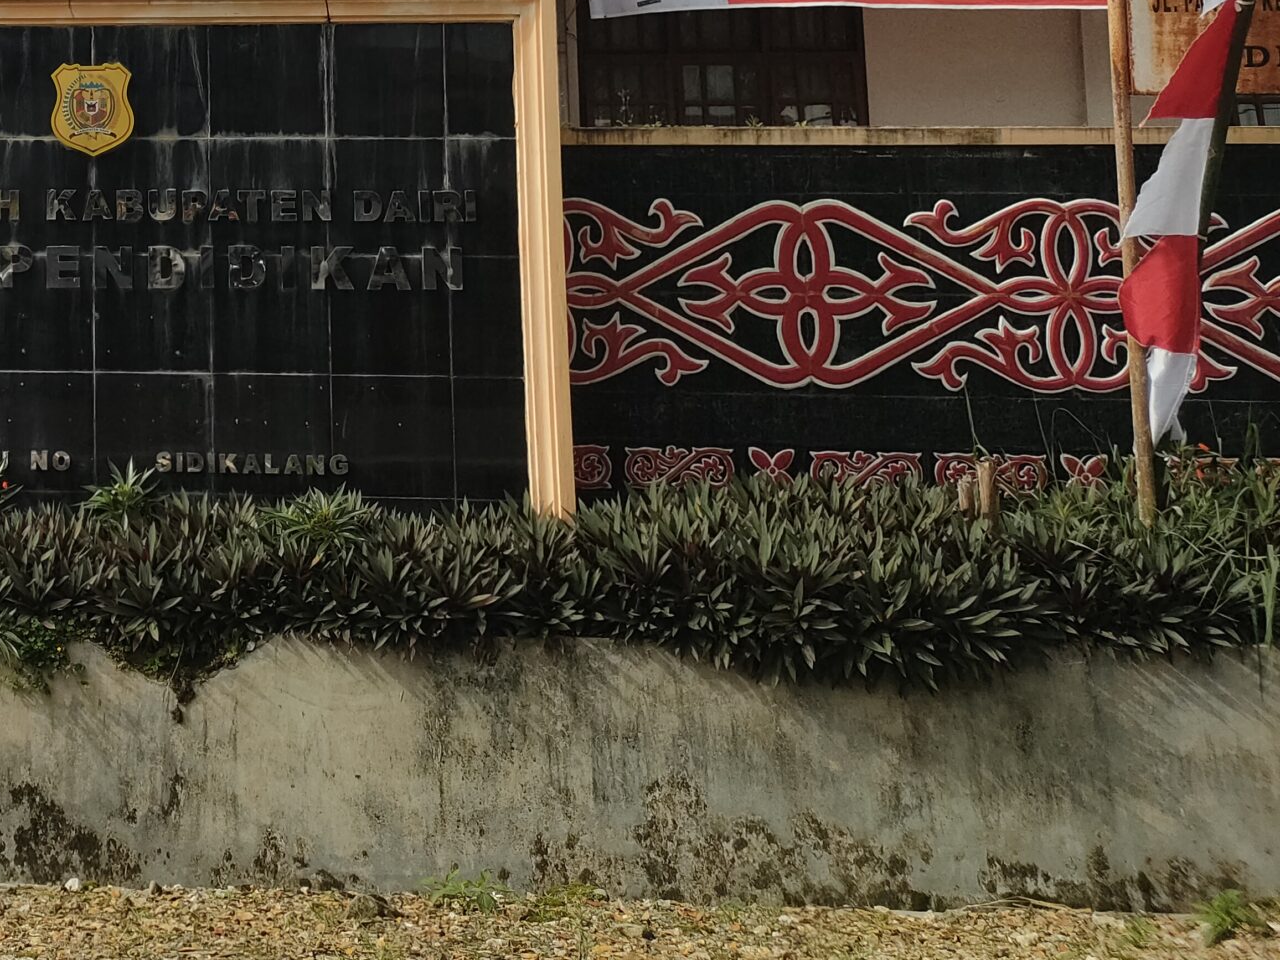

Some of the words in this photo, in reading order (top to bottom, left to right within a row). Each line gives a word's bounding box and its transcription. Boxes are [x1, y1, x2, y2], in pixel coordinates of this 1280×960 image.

[46, 188, 332, 222] KABUPATEN
[353, 189, 477, 223] DAIRI
[30, 449, 72, 471] NO
[154, 451, 350, 476] SIDIKALANG
